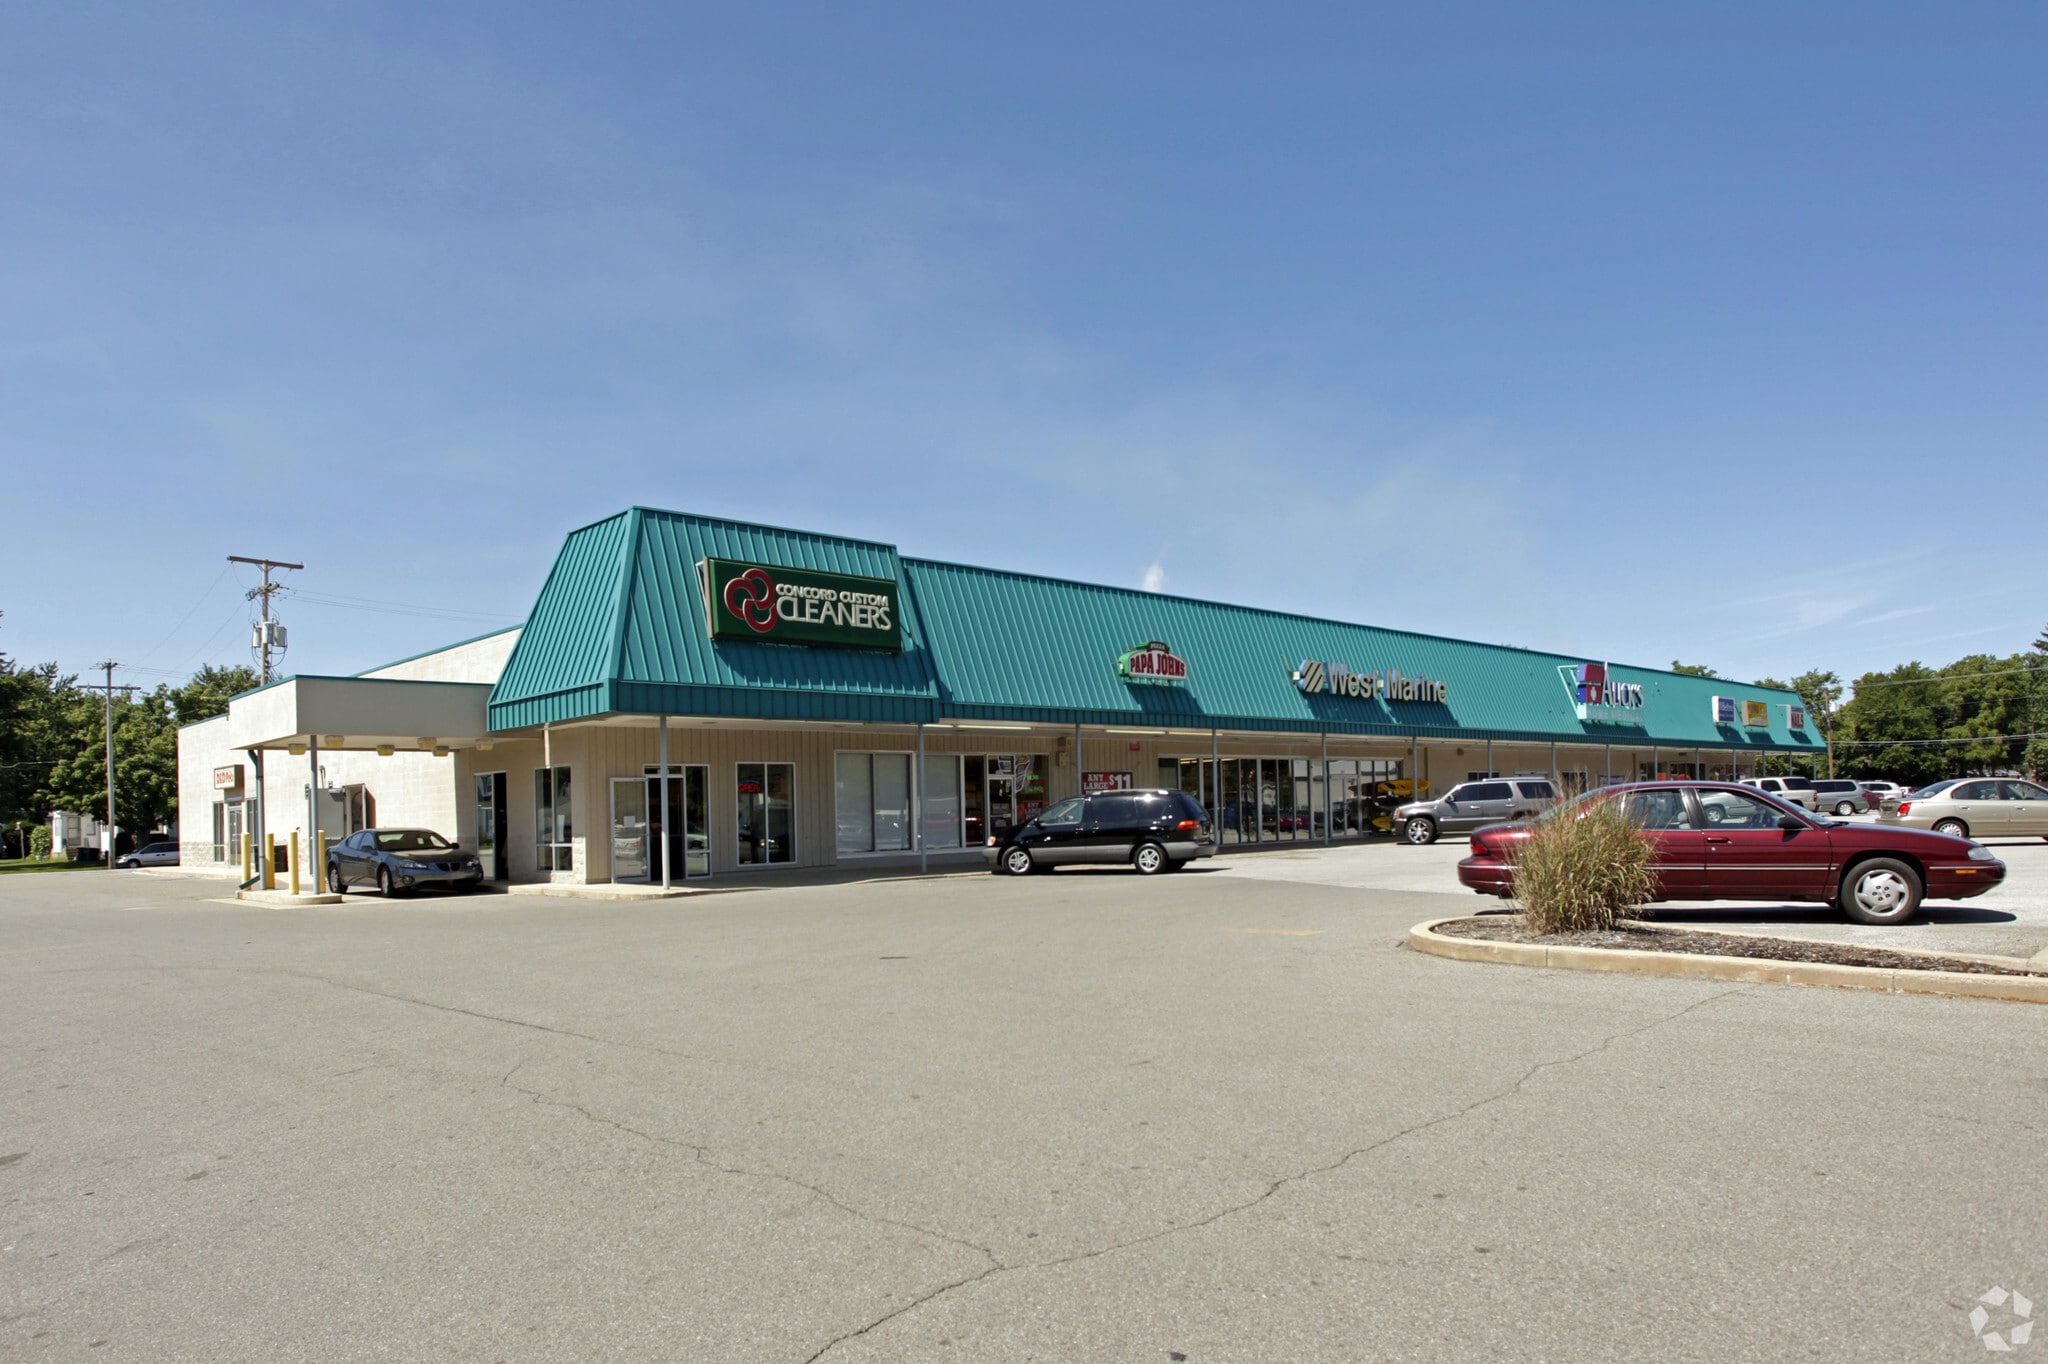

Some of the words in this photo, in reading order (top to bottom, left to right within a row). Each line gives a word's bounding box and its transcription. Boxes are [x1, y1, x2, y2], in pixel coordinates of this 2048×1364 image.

[775, 583, 837, 602] CONCORD
[839, 590, 889, 607] CUSTOM
[775, 596, 892, 631] CLEANERS
[1130, 653, 1154, 674] PAPA
[1324, 661, 1379, 699] West
[1384, 668, 1448, 703] Marine
[1083, 782, 1108, 790] LARGE
[1088, 774, 1104, 782] ANY
[1109, 774, 1131, 790] $11
